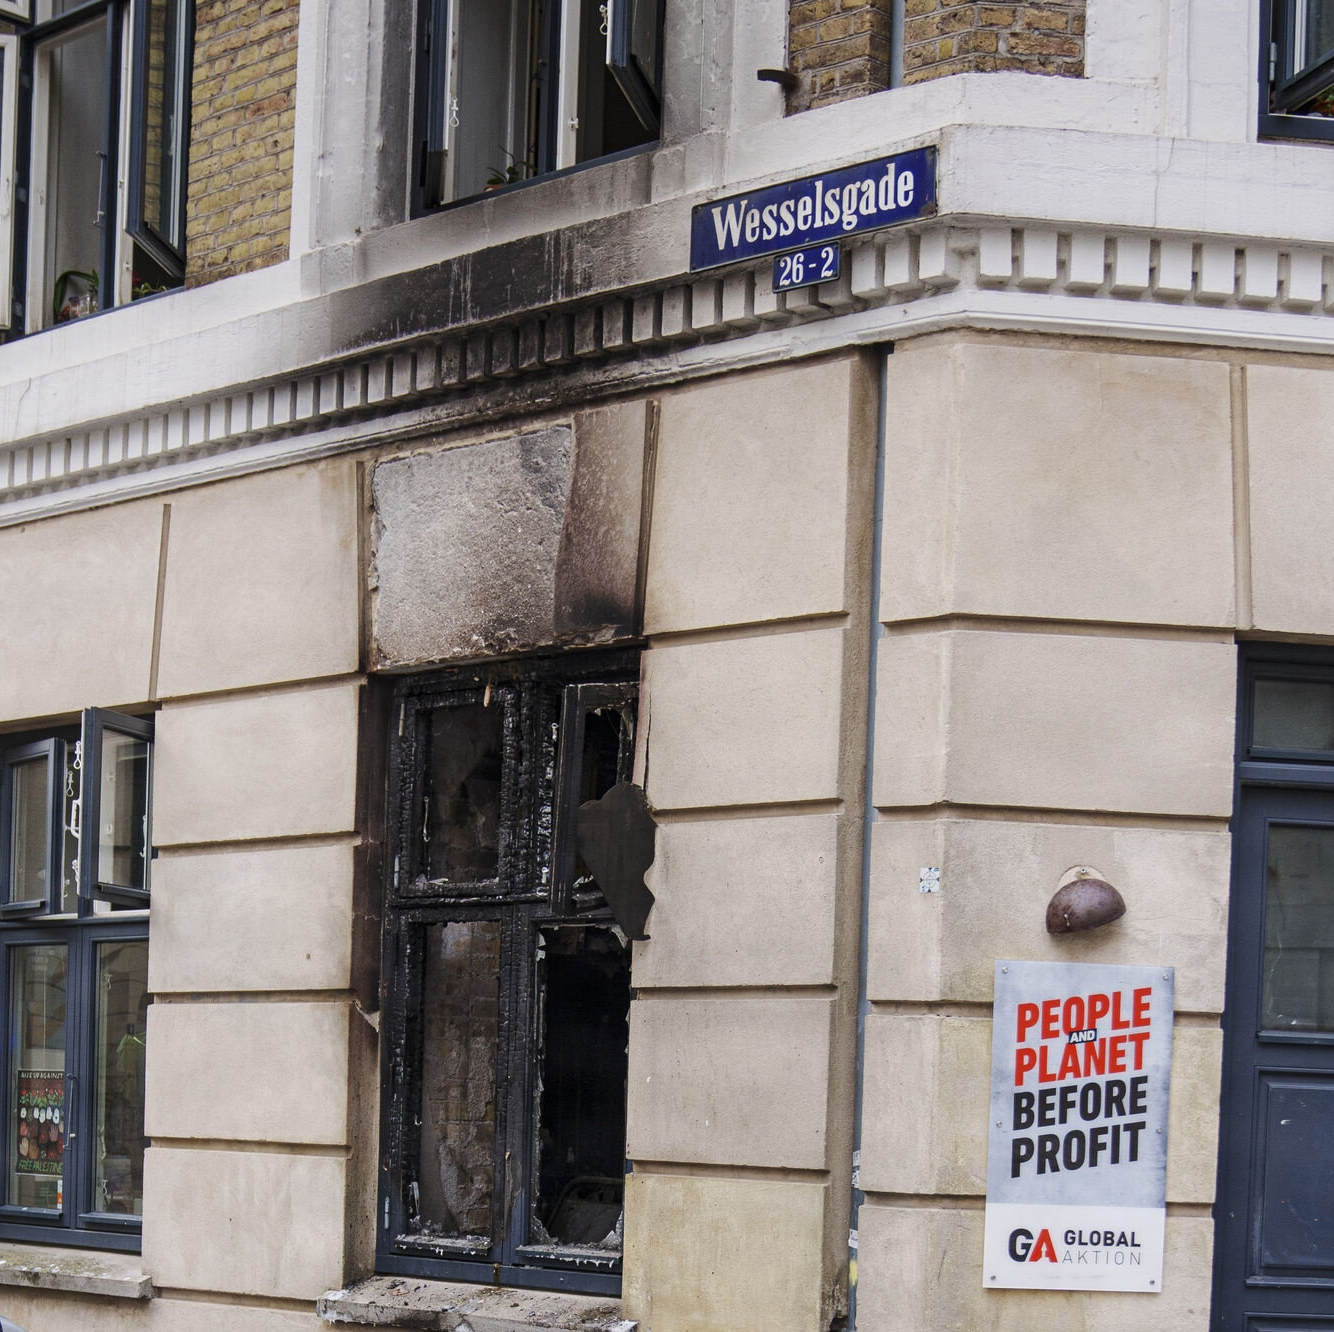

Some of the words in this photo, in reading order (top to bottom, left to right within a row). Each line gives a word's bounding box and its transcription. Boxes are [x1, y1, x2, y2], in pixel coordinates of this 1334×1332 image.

[711, 162, 914, 251] Wesselsgade
[1016, 987, 1152, 1044] PEOPLE
[1069, 1030, 1097, 1044] AND
[1014, 1032, 1151, 1087] PLANET
[1012, 1075, 1149, 1131] BEFORE
[1010, 1121, 1147, 1179] PROFIT
[1008, 1228, 1058, 1263] GA
[1062, 1250, 1142, 1266] AKTION
[1064, 1230, 1142, 1247] GLOBAL
